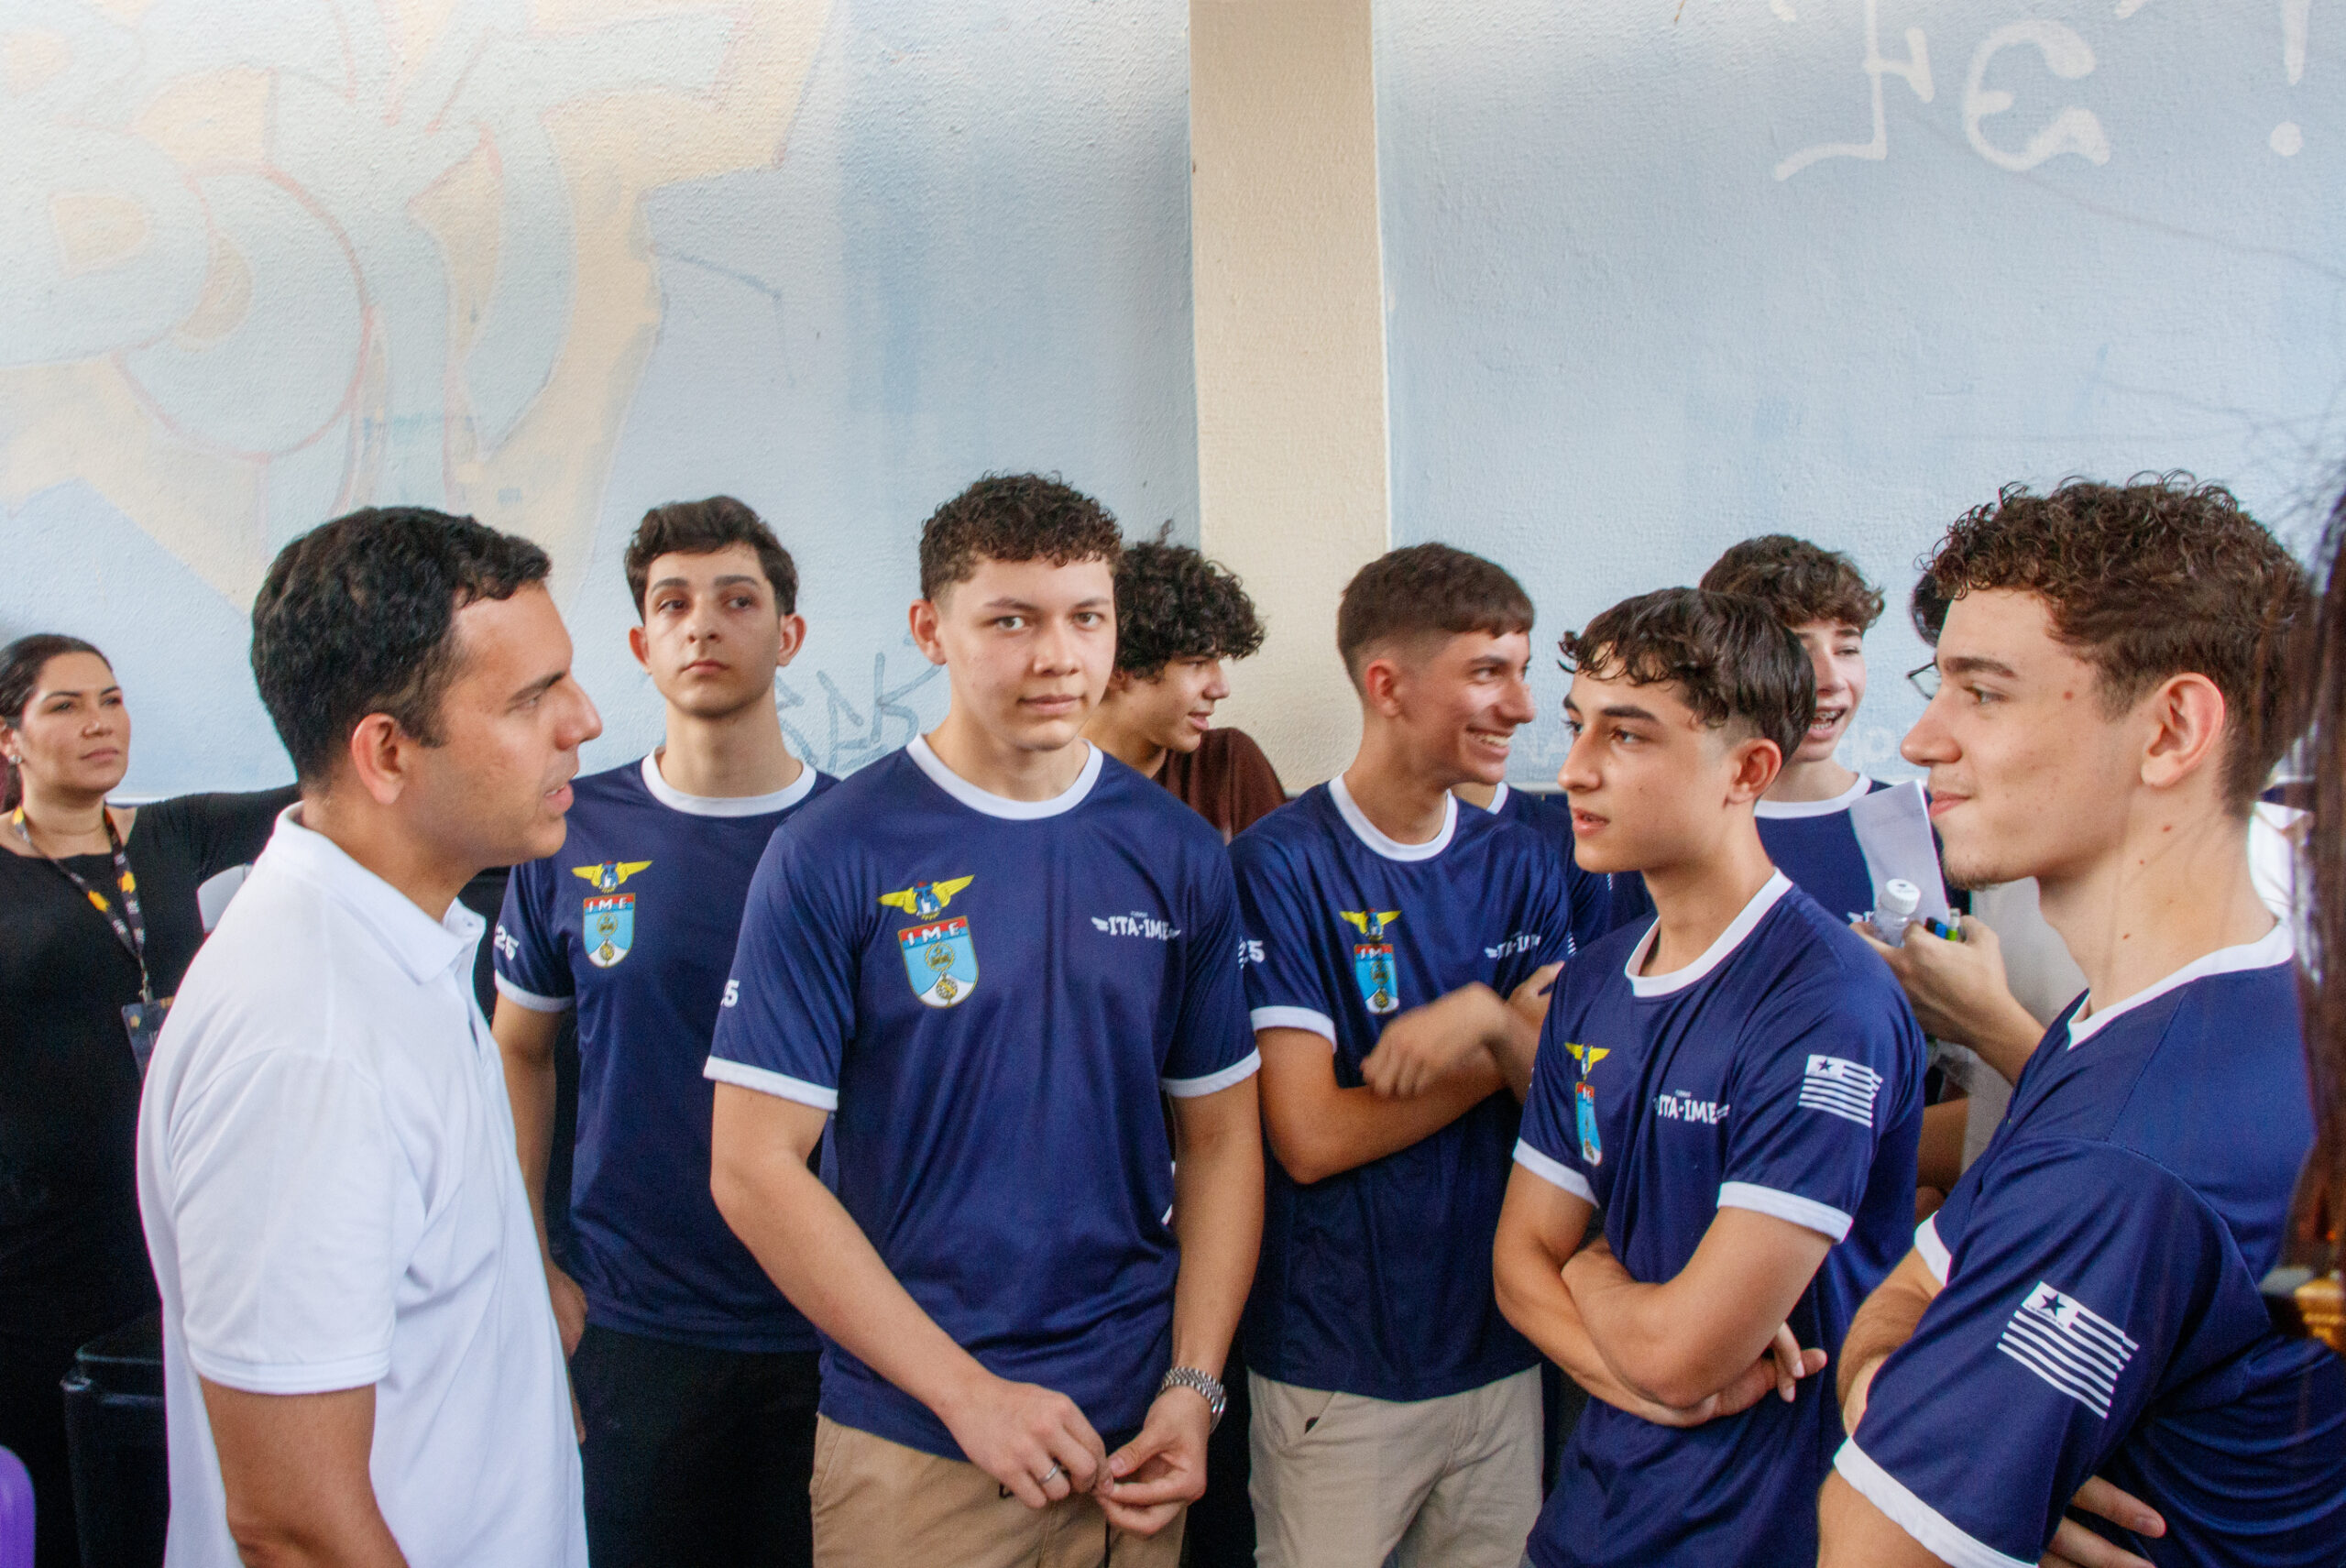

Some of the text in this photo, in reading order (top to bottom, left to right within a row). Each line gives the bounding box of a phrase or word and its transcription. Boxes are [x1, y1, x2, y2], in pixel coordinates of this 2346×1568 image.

[588, 897, 628, 913] IME
[493, 925, 520, 960] 25
[907, 921, 960, 947] IME
[720, 979, 740, 1008] 5
